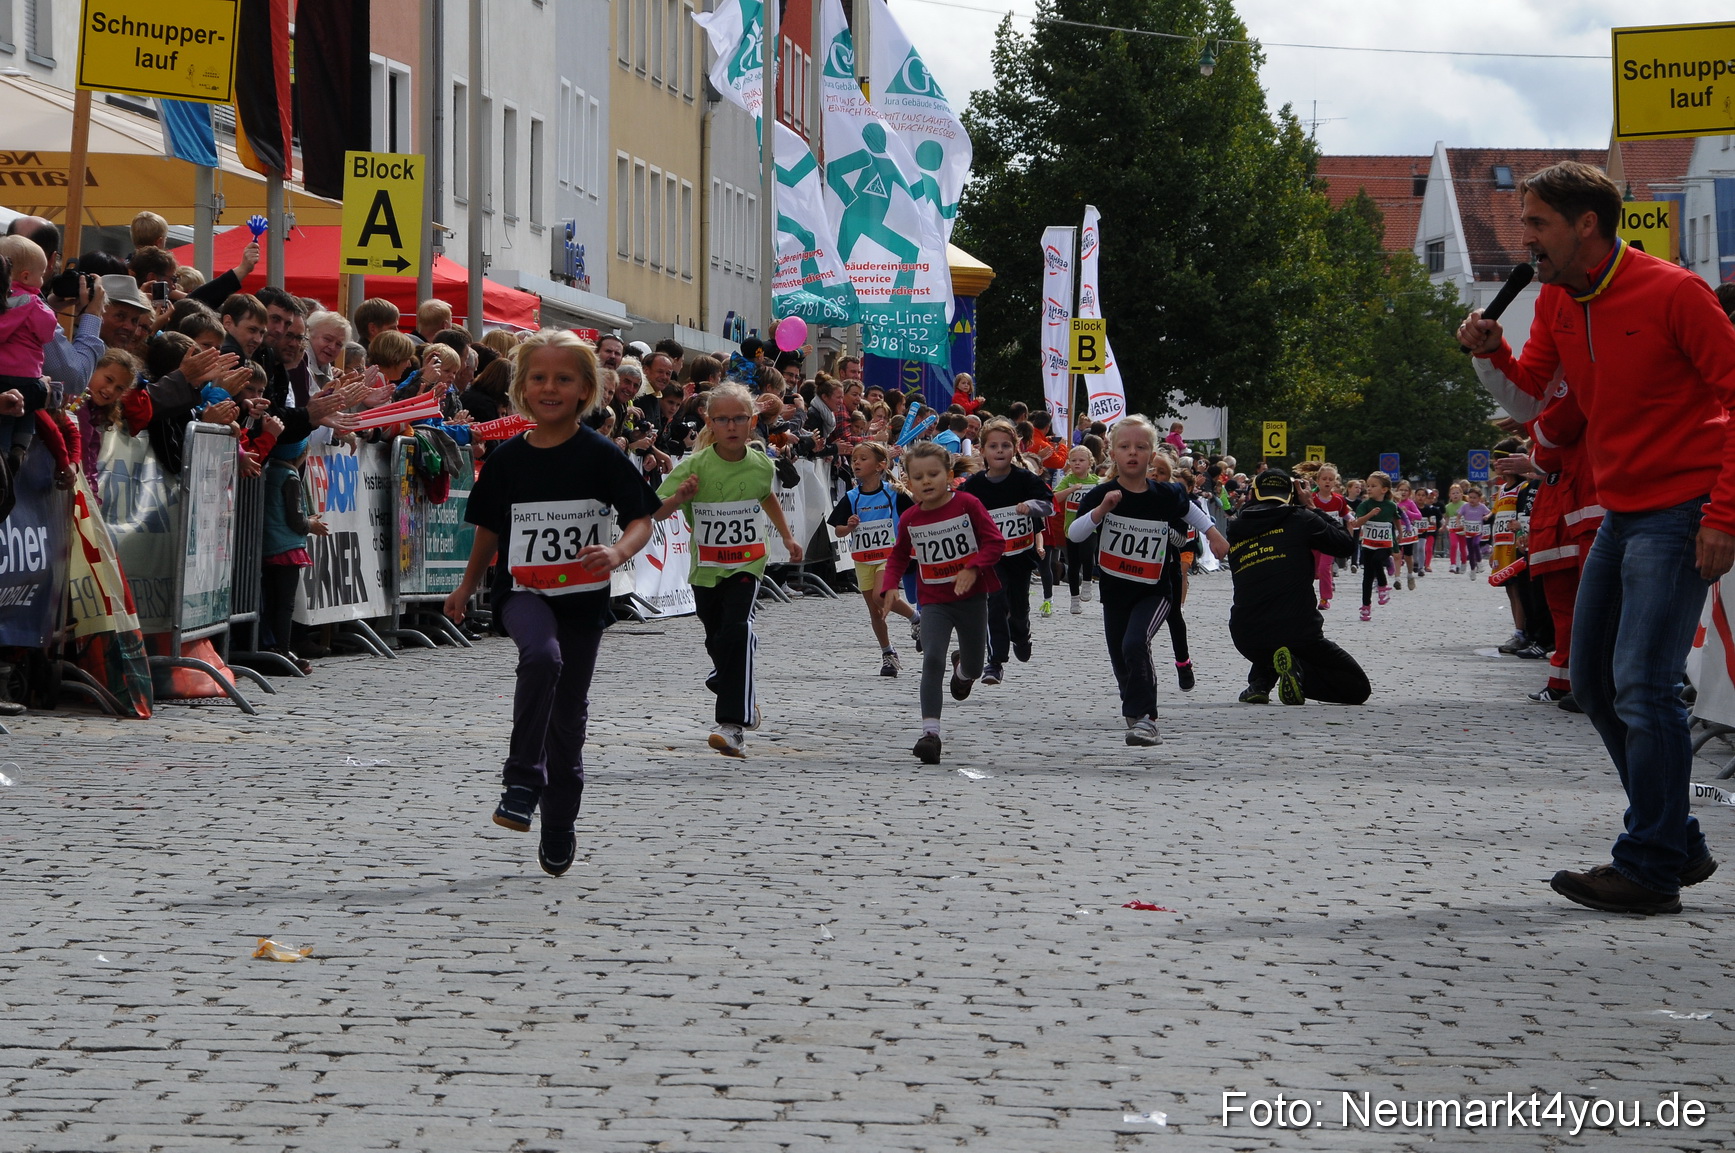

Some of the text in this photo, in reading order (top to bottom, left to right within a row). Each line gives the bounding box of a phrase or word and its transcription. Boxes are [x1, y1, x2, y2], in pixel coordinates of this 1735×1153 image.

[91, 12, 225, 46] Schnupper-
[135, 46, 178, 71] lauf
[885, 97, 899, 105] Jura
[902, 97, 932, 108] Gebäude
[1670, 86, 1713, 108] lauf
[902, 113, 922, 122] UNS
[353, 155, 415, 181] Block
[357, 189, 403, 249] A
[1621, 207, 1669, 230] lock
[1073, 320, 1102, 331] Block
[1078, 335, 1096, 362] B
[474, 421, 500, 433] Audi
[1269, 432, 1280, 448] C
[1471, 471, 1488, 479] TAXI
[514, 509, 595, 522] PARTL Neumarkt
[694, 507, 751, 517] PARTL Neumarkt
[701, 518, 756, 545] 7235
[928, 525, 961, 536] Neumarkt
[1105, 518, 1160, 534] PARTL Neumarkt
[1366, 528, 1389, 539] 7048
[917, 533, 969, 563] 7208
[1109, 529, 1161, 559] 7047
[1259, 546, 1274, 554] Tag
[717, 549, 743, 560] Alina
[1119, 561, 1144, 575] Anne
